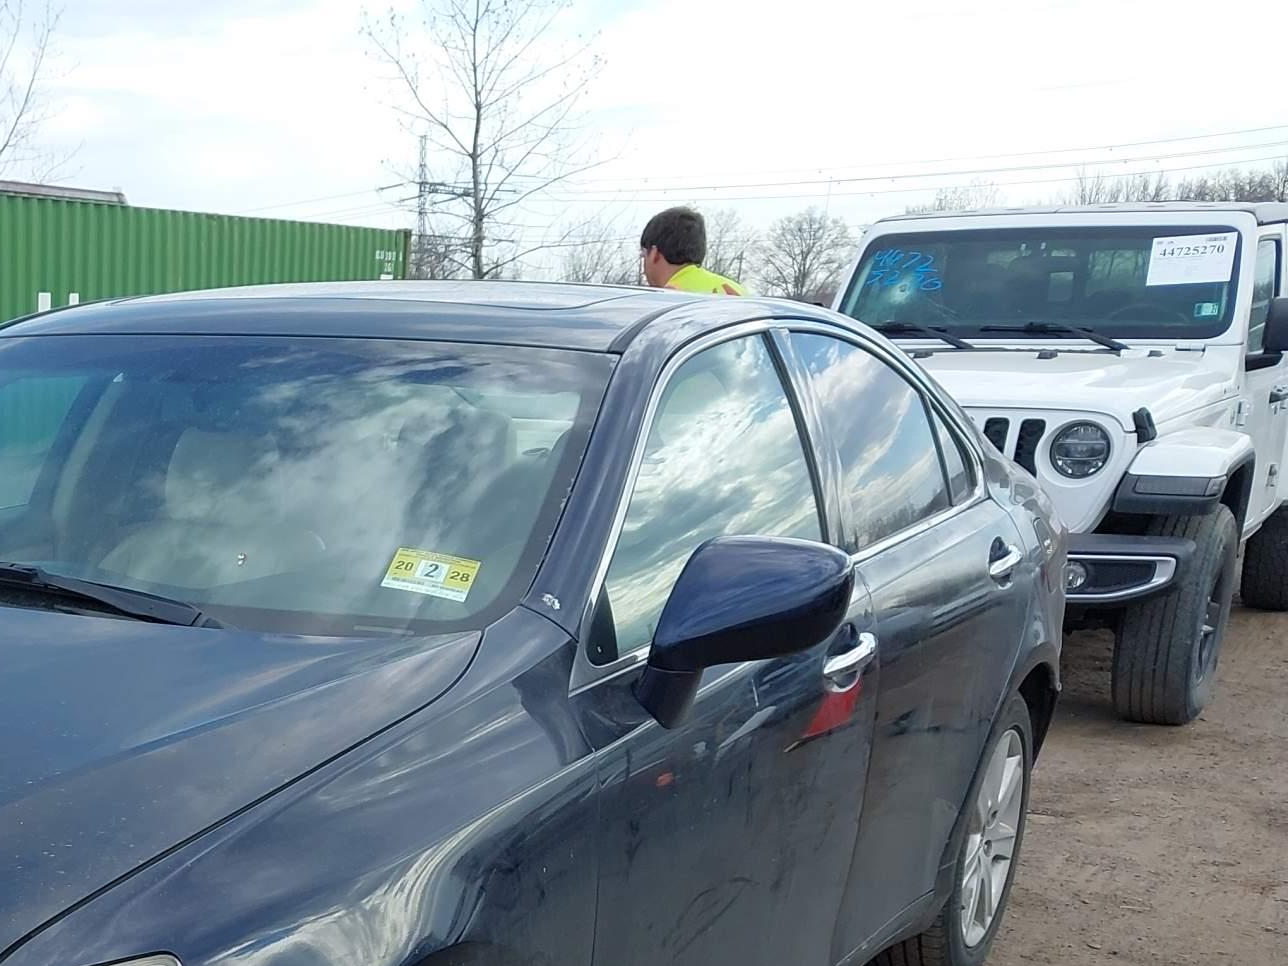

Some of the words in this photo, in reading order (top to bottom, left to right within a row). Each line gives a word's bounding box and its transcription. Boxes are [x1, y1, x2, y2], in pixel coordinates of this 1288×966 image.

[1159, 244, 1225, 257] 44725270
[395, 560, 414, 571] 20
[424, 563, 440, 578] 2
[449, 570, 470, 582] 28
